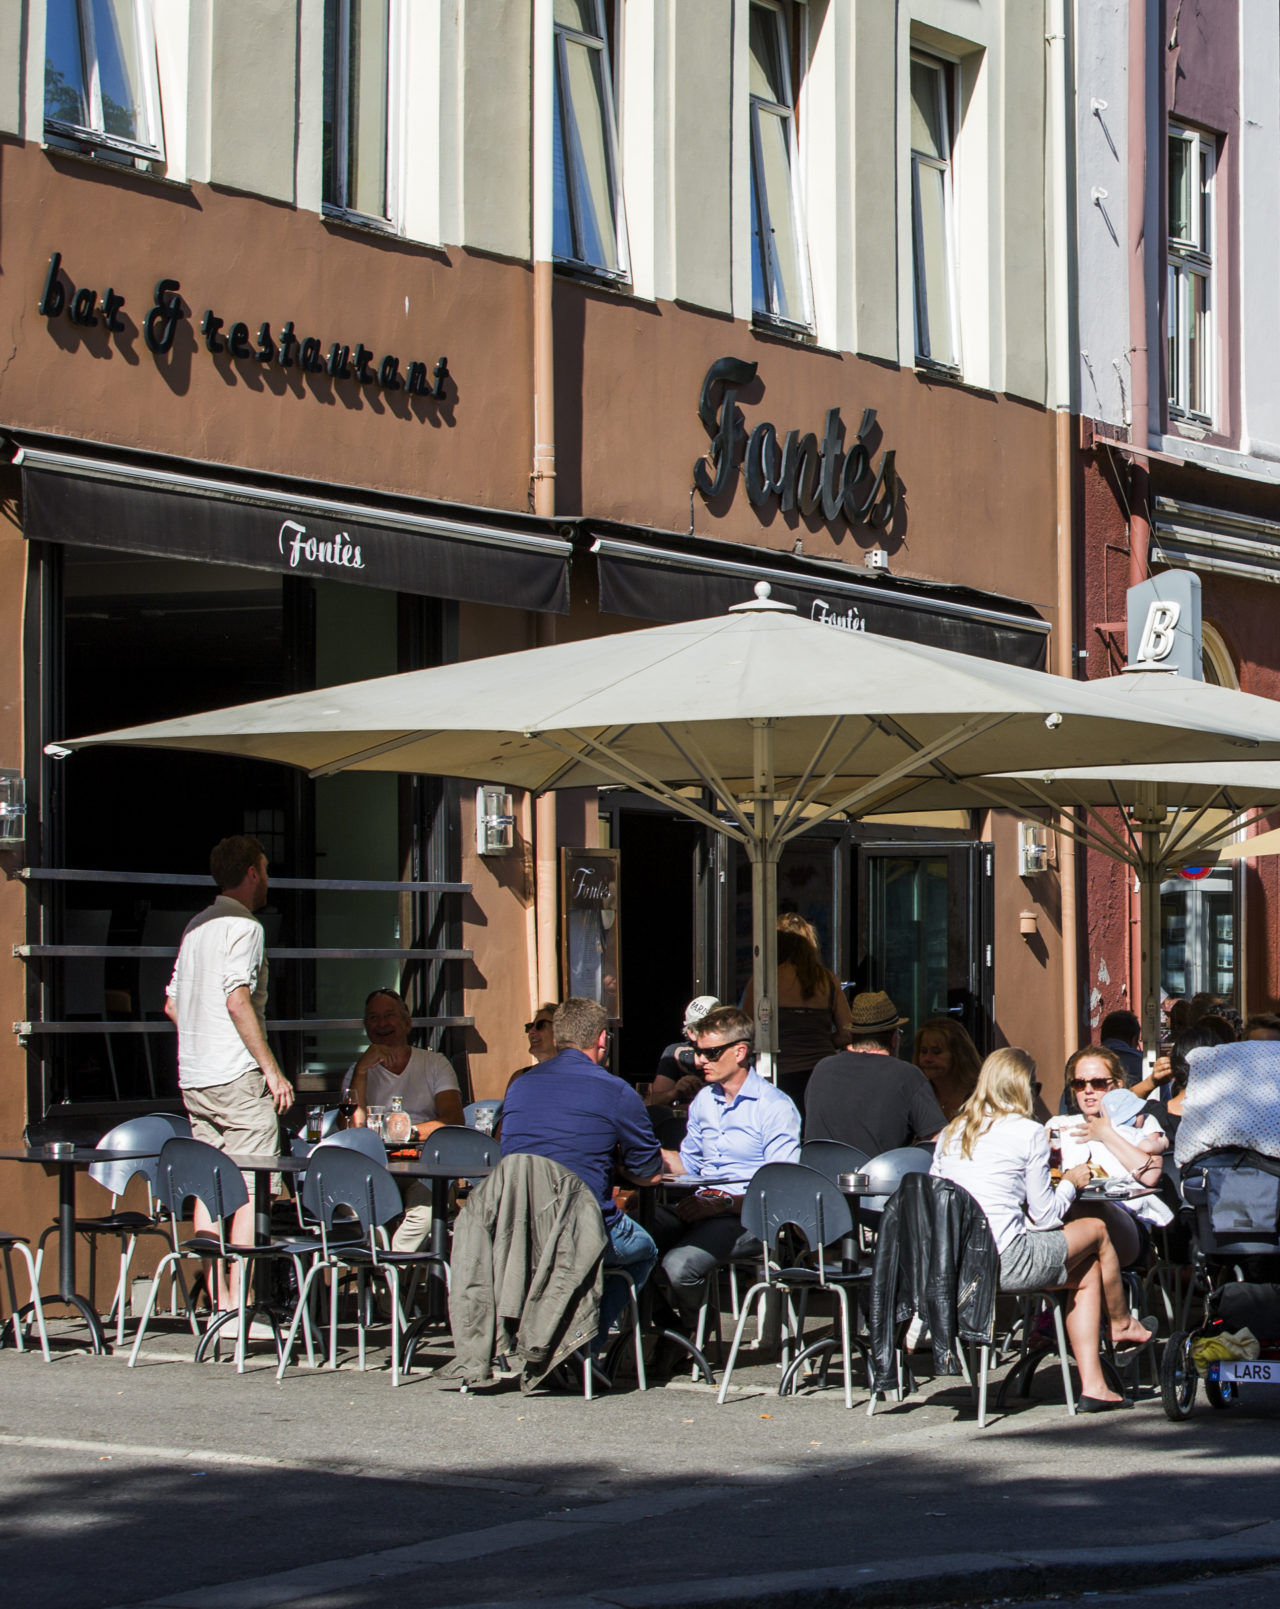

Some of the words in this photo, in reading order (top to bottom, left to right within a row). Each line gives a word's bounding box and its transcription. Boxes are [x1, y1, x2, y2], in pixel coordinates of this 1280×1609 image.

[39, 252, 125, 333] bar
[144, 279, 184, 354] &
[201, 309, 449, 400] restaurant
[279, 519, 366, 569] Fontès
[1234, 1364, 1272, 1380] LARS
